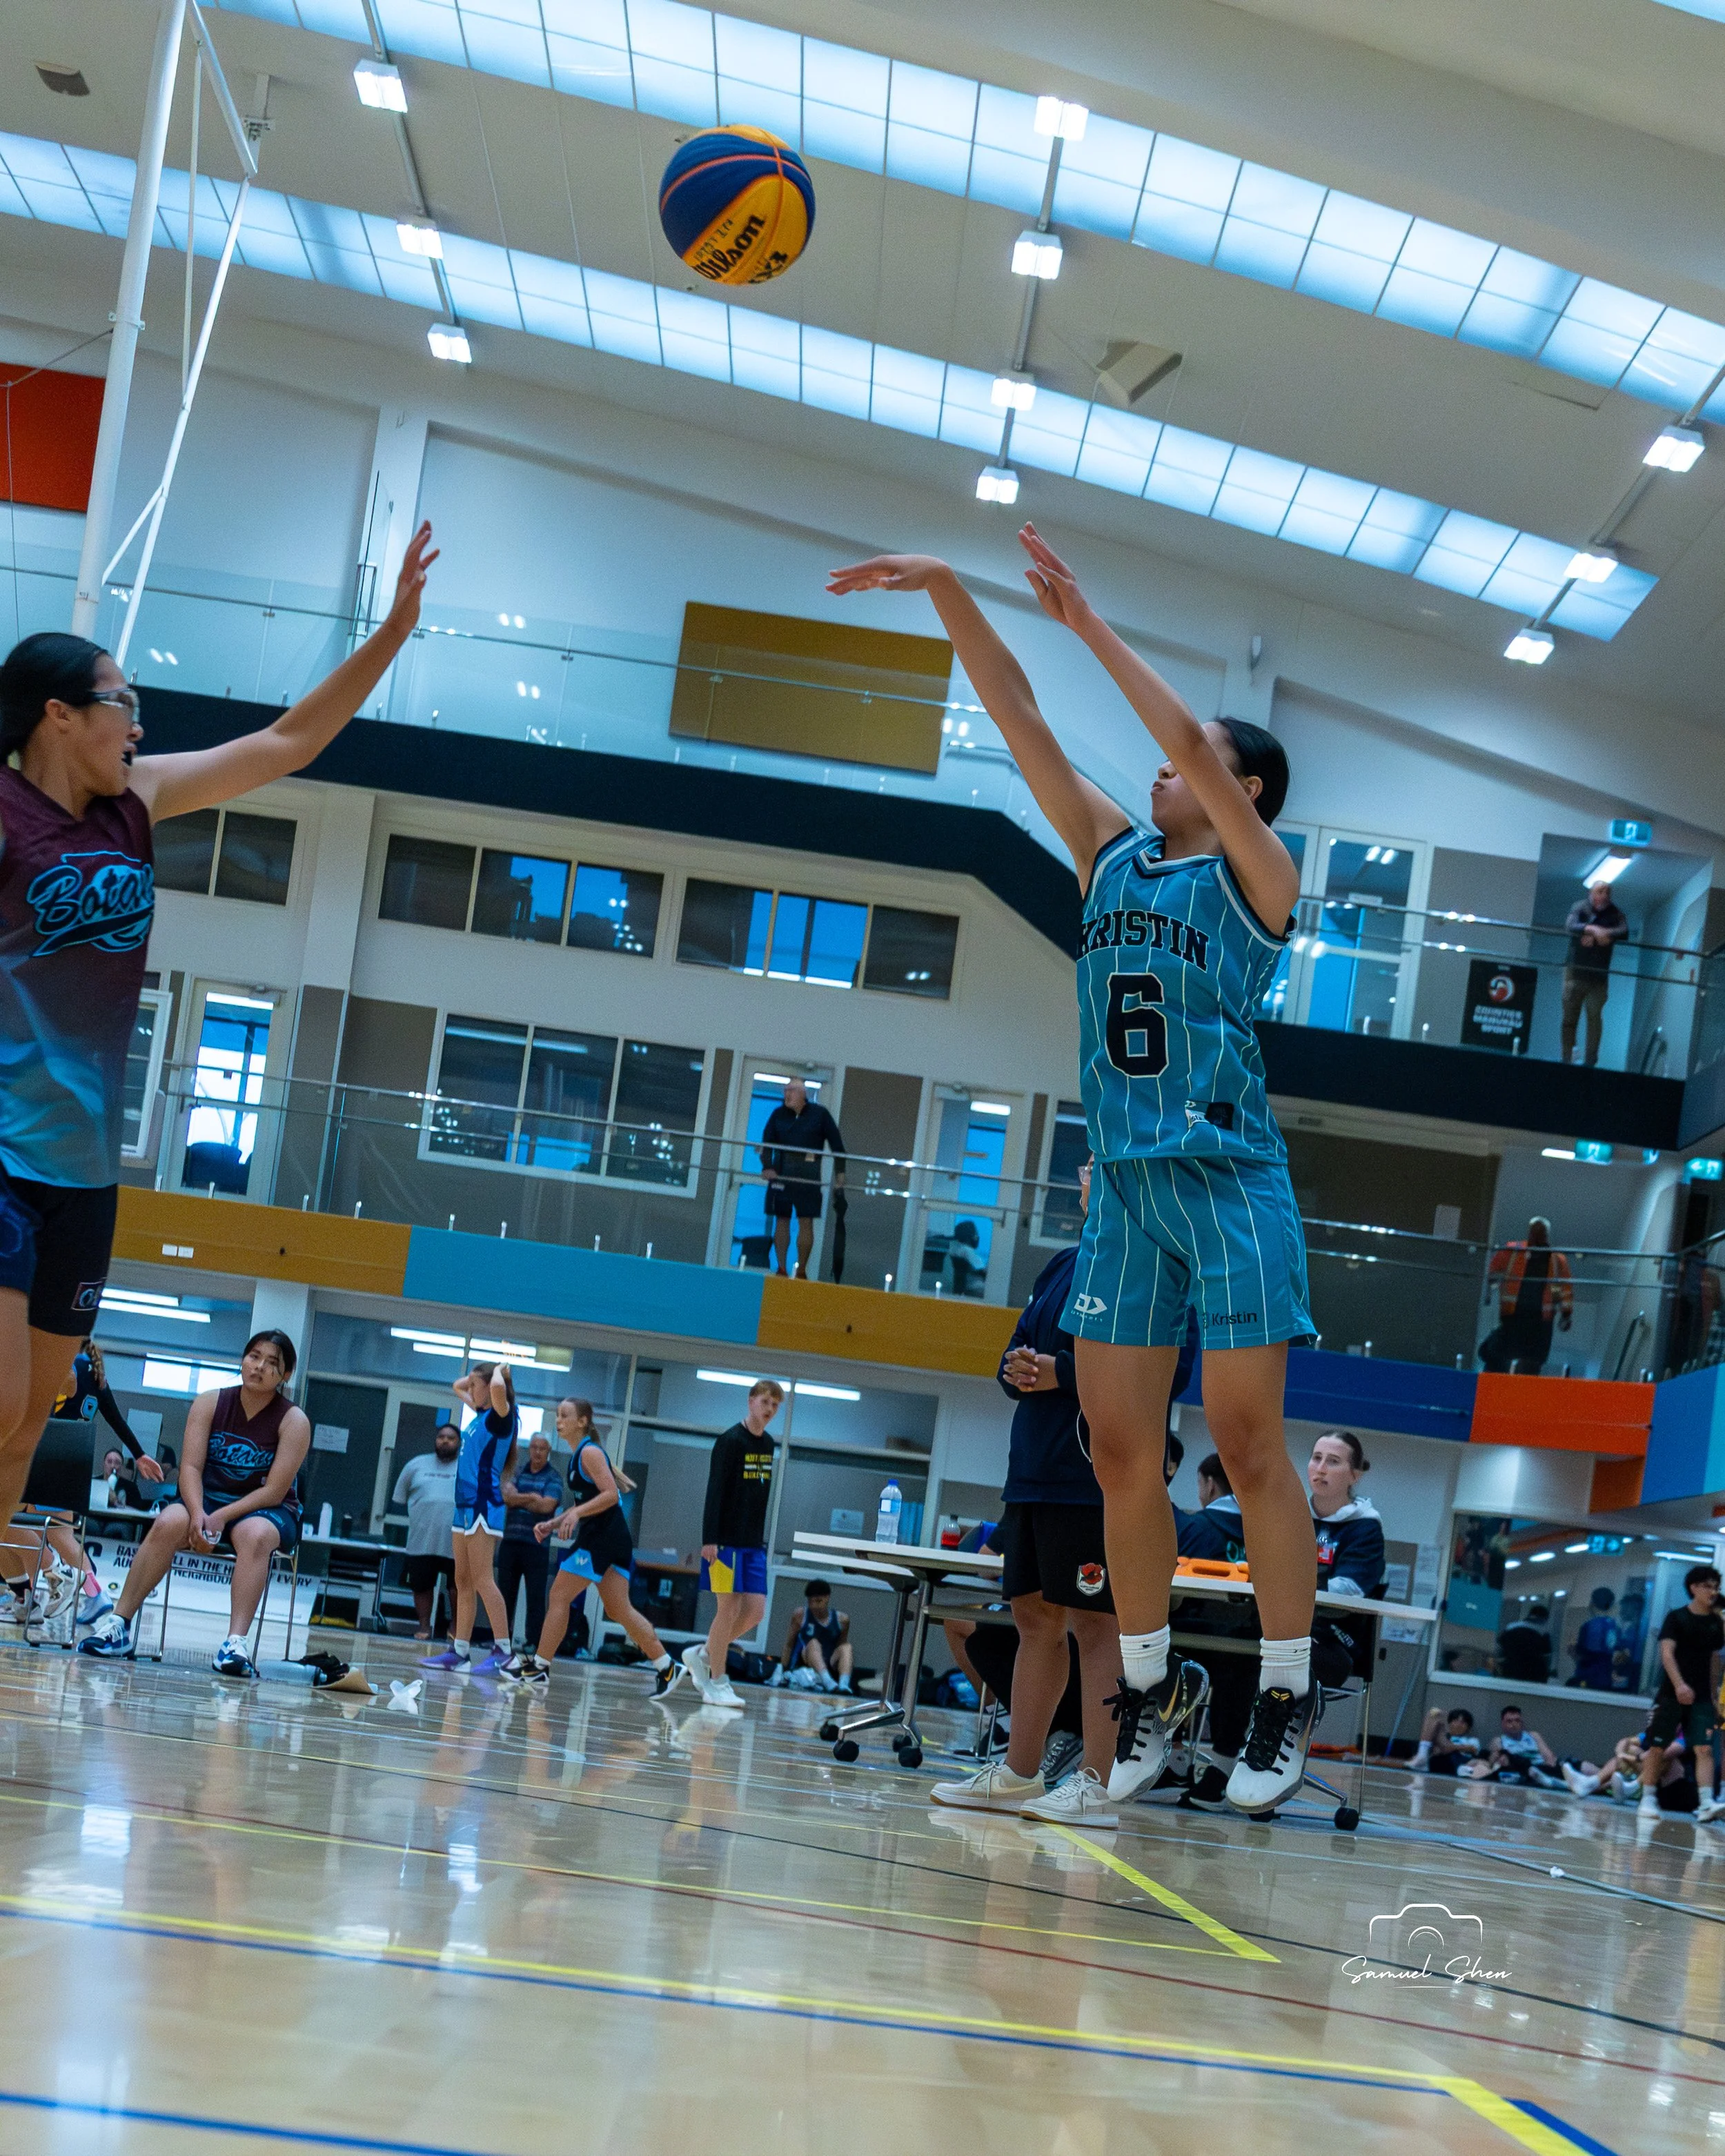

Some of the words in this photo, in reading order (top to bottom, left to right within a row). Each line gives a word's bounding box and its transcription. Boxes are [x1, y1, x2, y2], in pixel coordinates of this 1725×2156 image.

[1077, 909, 1210, 974] KRISTIN
[1105, 972, 1170, 1079] 6
[1212, 1312, 1258, 1326] Kristin
[187, 1557, 199, 1569] IN
[202, 1559, 223, 1572] THE
